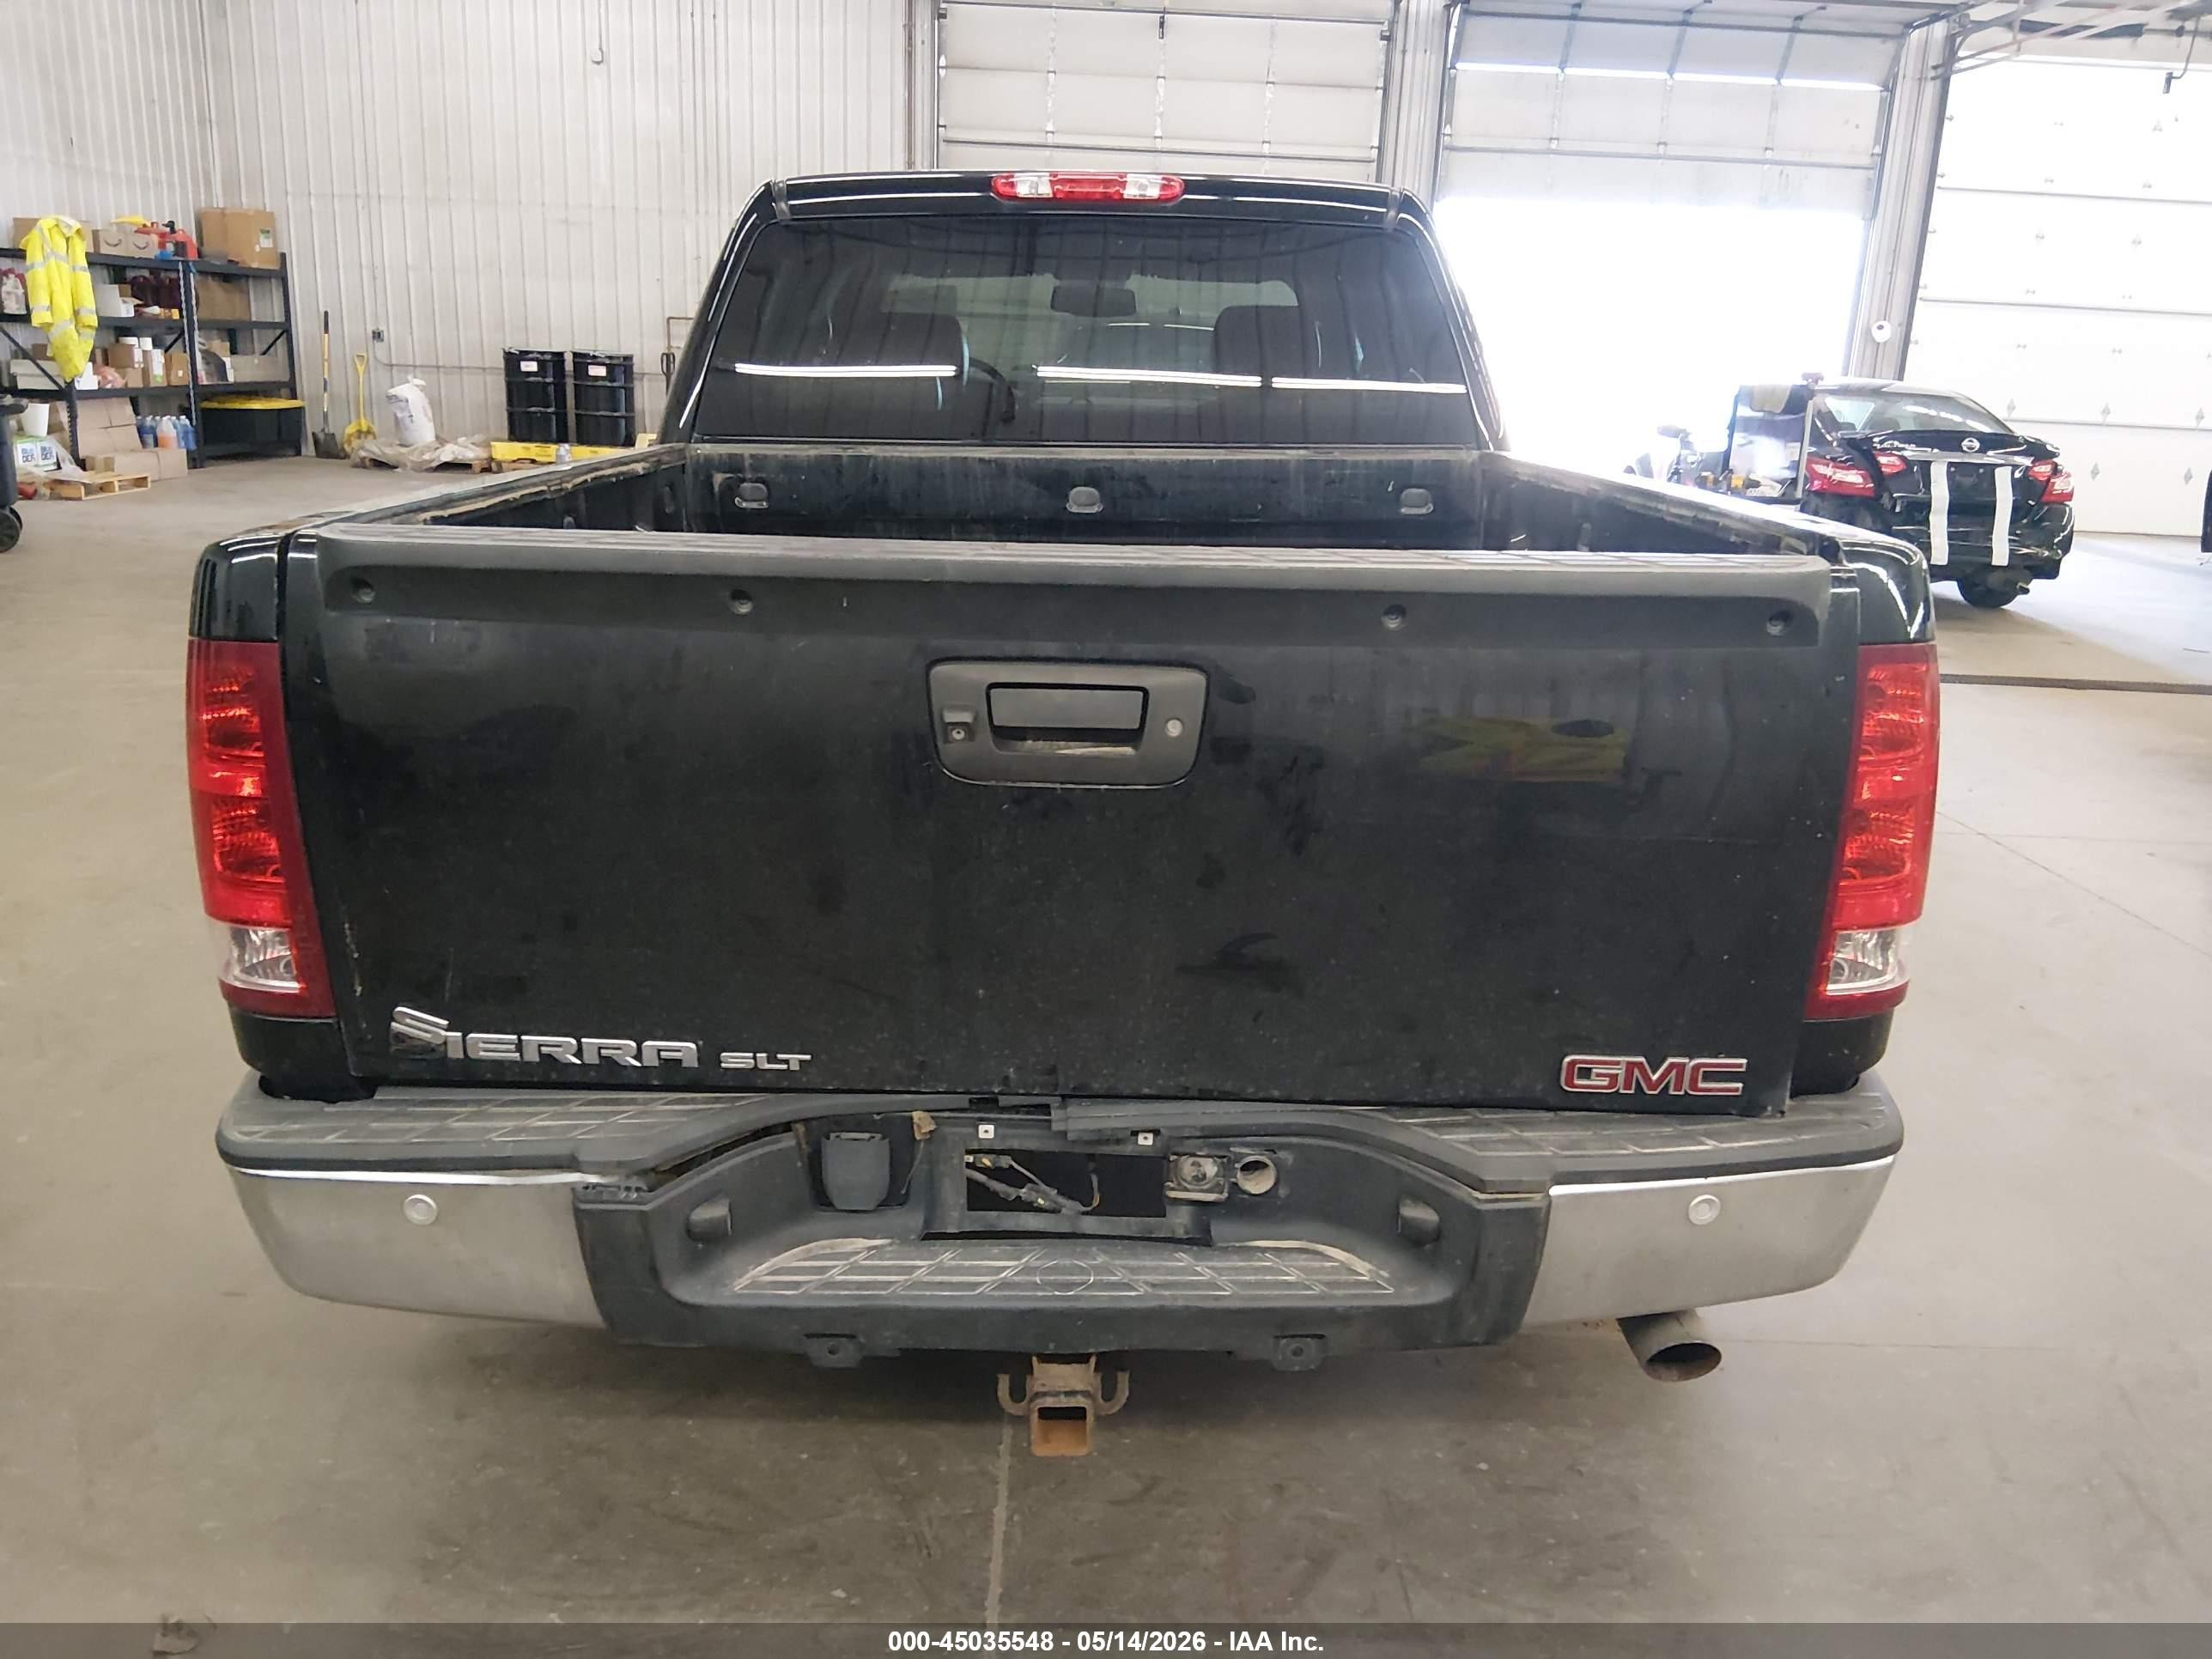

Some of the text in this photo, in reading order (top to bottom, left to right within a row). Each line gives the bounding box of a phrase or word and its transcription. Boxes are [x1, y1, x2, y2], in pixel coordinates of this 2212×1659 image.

[391, 1006, 812, 1072] SIERRA SLT
[1560, 1054, 1747, 1096] GMC
